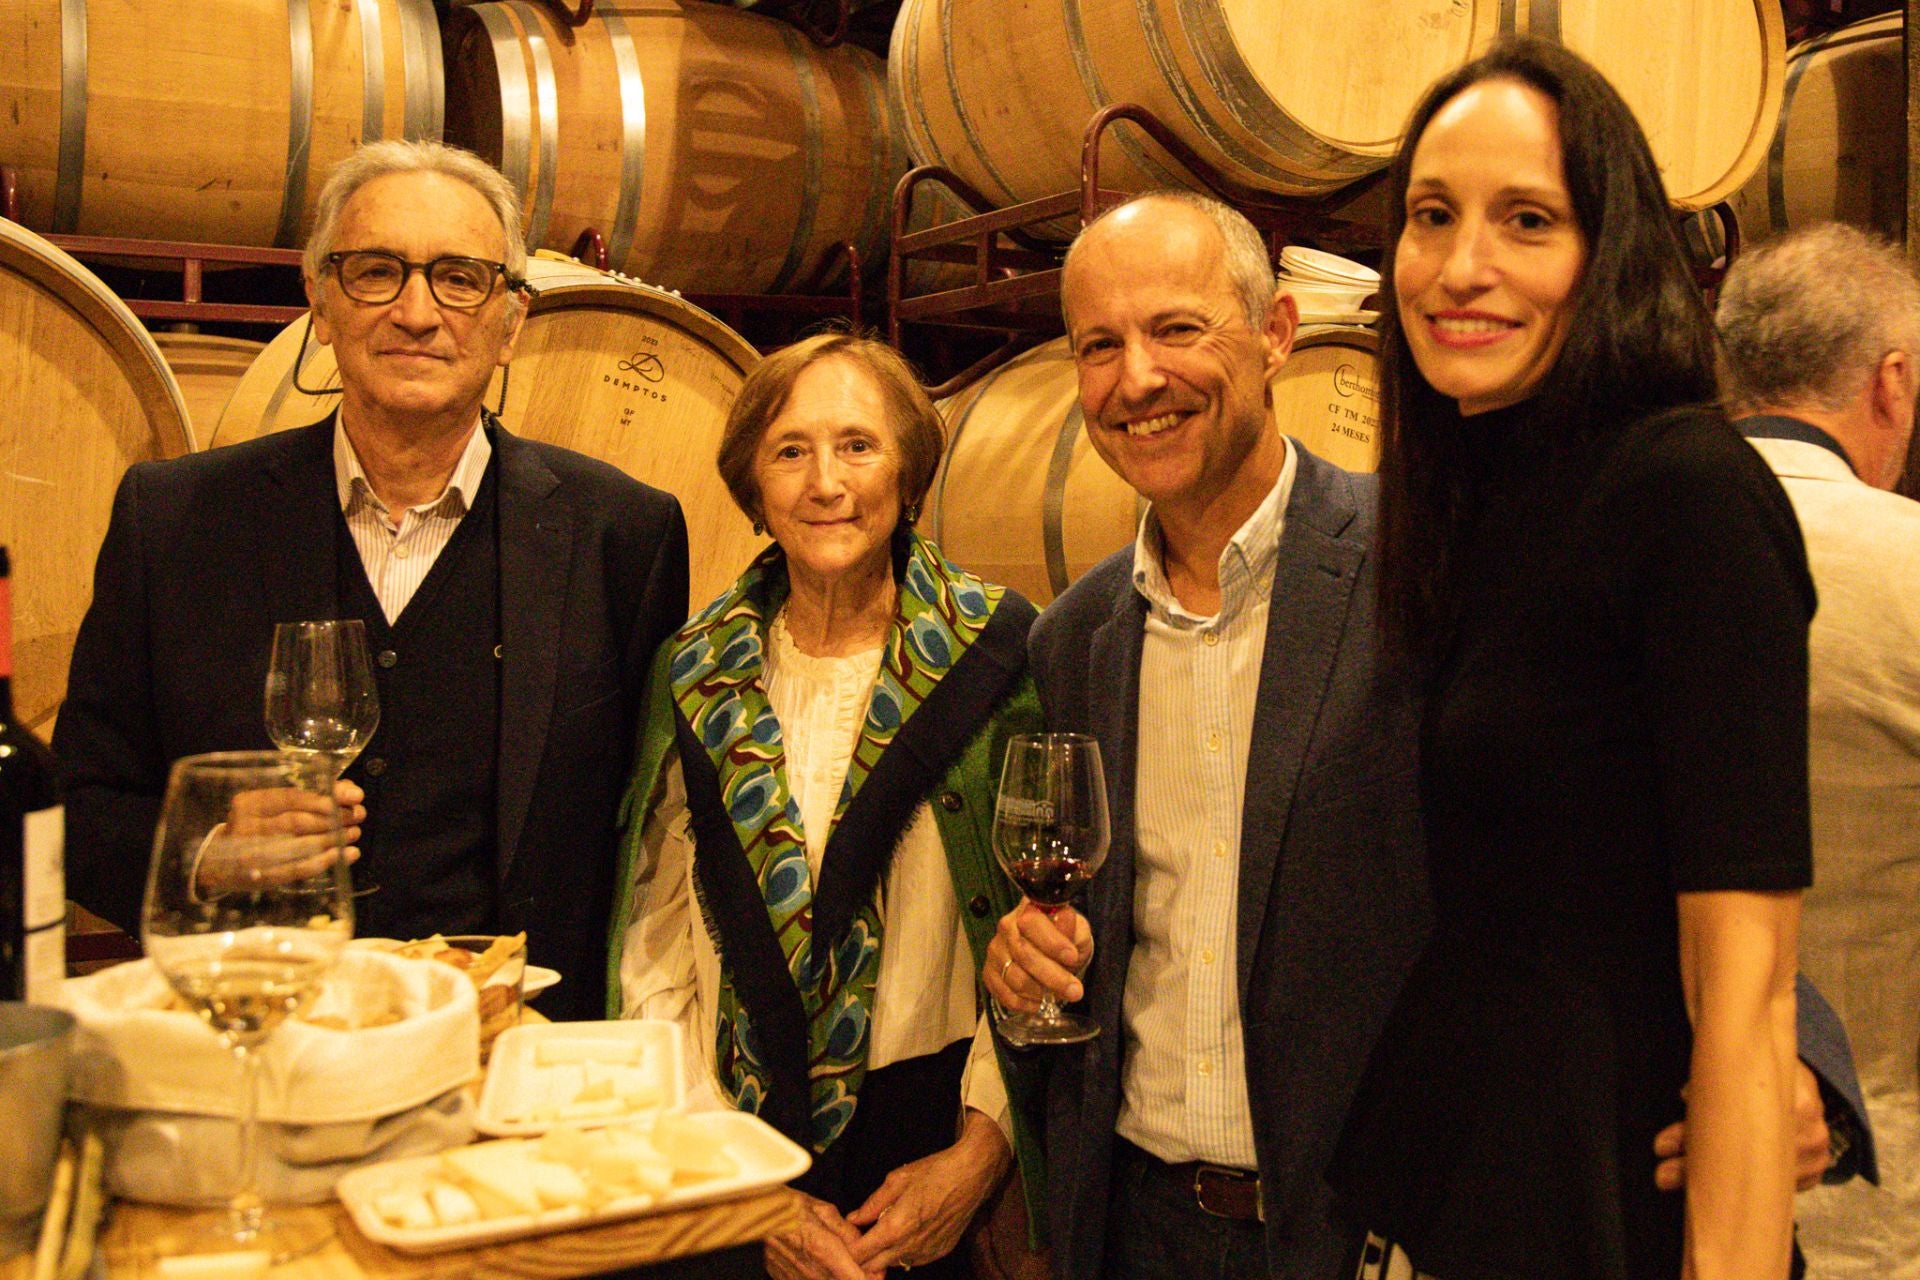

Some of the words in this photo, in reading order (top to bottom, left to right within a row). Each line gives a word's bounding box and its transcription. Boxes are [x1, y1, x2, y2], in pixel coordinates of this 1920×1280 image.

[603, 375, 668, 402] DEMPTOS
[1328, 403, 1341, 414] CF
[1344, 408, 1359, 422] TM
[1331, 422, 1341, 433] 24
[1342, 426, 1370, 444] MESES
